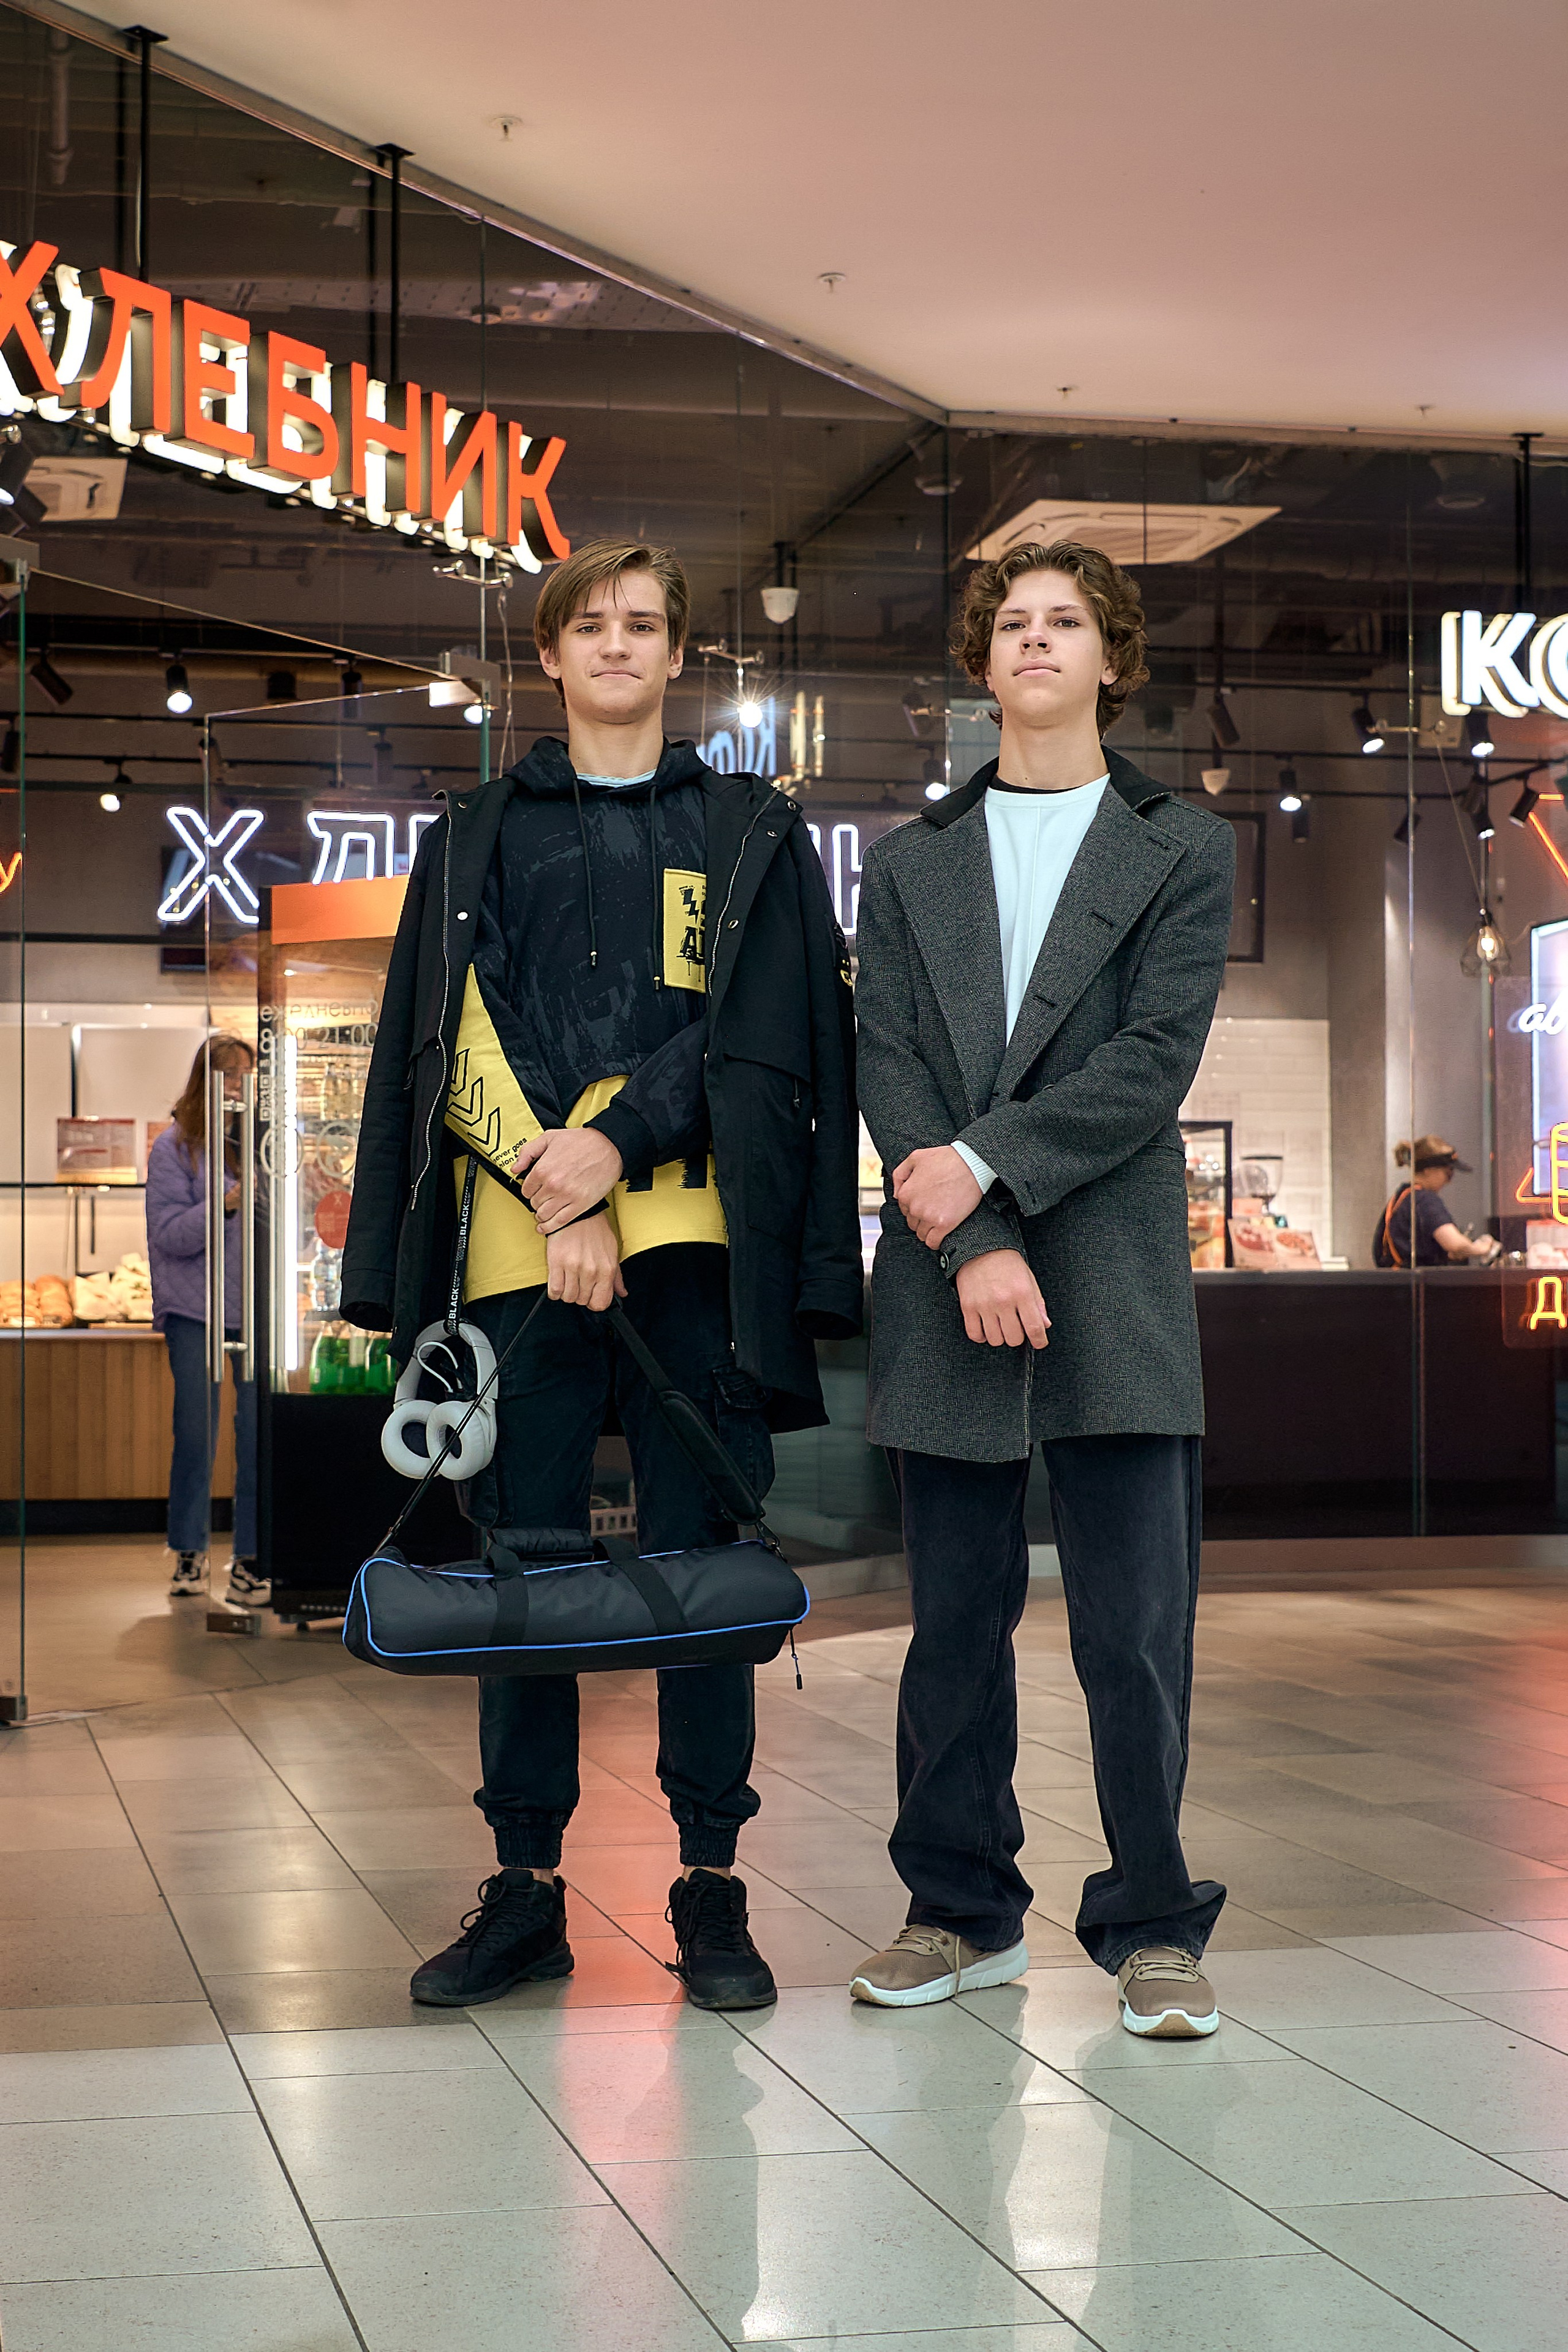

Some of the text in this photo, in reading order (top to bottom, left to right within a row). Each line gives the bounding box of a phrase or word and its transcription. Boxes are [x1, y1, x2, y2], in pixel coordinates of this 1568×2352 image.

[1461, 610, 1568, 707] К
[512, 1137, 527, 1152] goes
[460, 1204, 470, 1235] BLACK
[448, 1288, 459, 1319] BLACK
